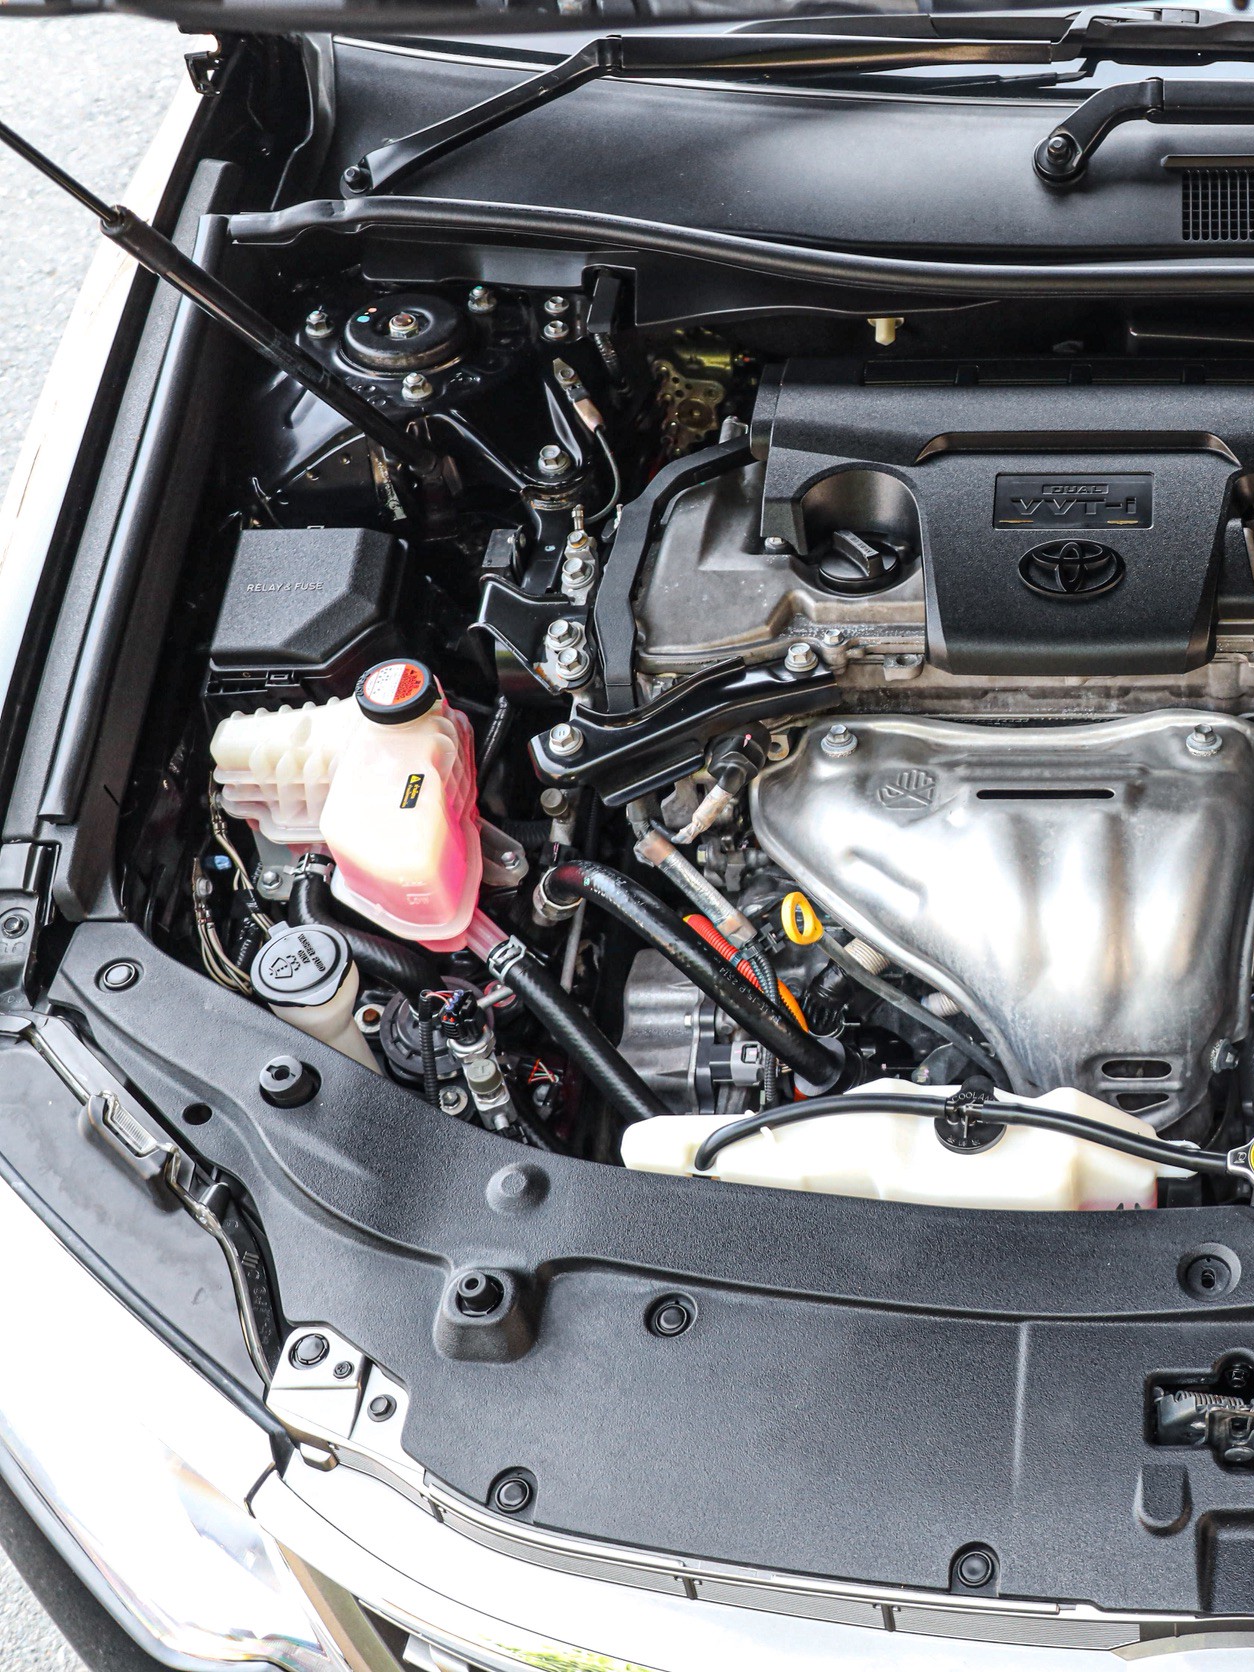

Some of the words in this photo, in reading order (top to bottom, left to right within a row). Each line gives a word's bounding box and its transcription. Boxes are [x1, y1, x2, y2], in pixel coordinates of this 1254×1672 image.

[246, 583, 283, 593] RELAY
[283, 582, 292, 591] &
[294, 582, 324, 591] FUSE
